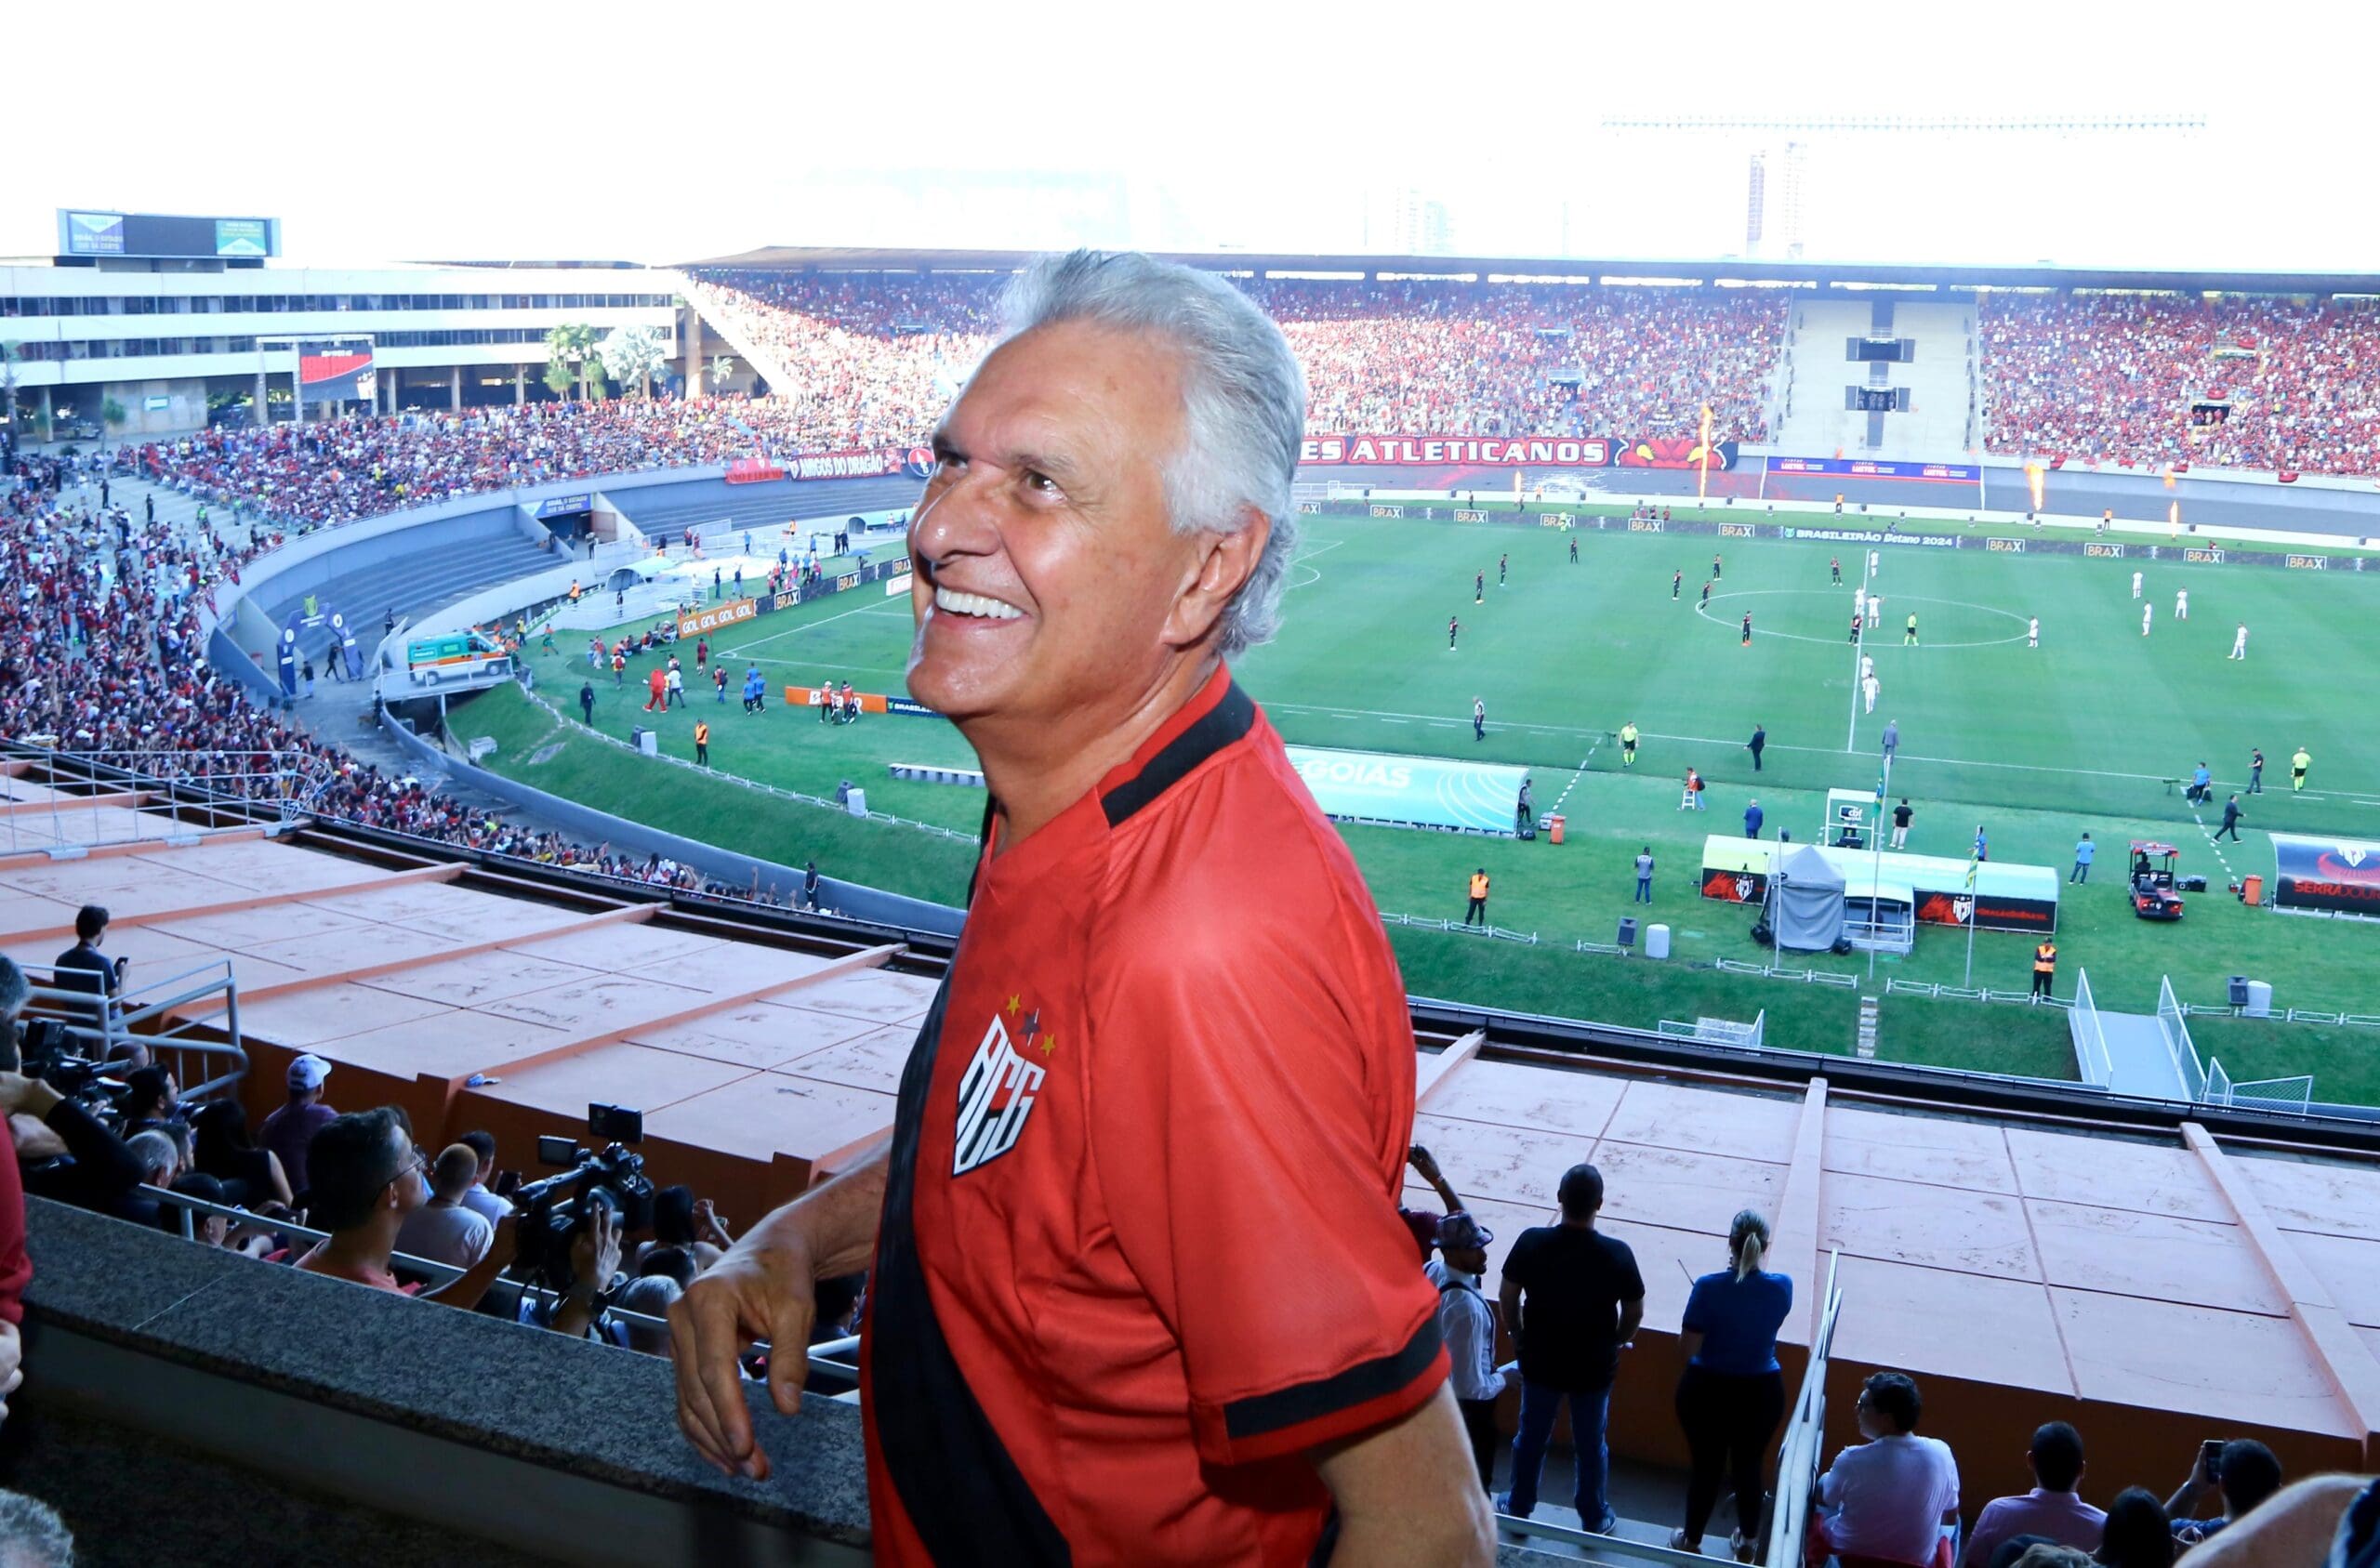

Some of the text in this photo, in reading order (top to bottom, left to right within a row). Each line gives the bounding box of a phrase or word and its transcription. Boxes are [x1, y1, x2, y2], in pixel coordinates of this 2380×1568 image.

[1352, 440, 1605, 463] ATLETICANOS
[800, 456, 834, 478] AMIGOS
[834, 456, 847, 476] DO
[847, 452, 883, 476] DRAGÃO
[1373, 507, 1400, 519] BRAX
[1457, 511, 1486, 523] BRAX
[1631, 520, 1660, 533] BRAX
[1721, 525, 1752, 538] BRAX
[1796, 529, 1952, 547] BRASILEIRÃO Betano 2024
[1990, 540, 2021, 553] BRAX
[2088, 546, 2121, 559] BRAX
[2188, 551, 2220, 564] BRAX
[2289, 557, 2323, 570] BRAX
[839, 573, 859, 591] BRAX
[776, 591, 799, 610] BRAX
[682, 604, 752, 634] GOL GOL GOL GOL
